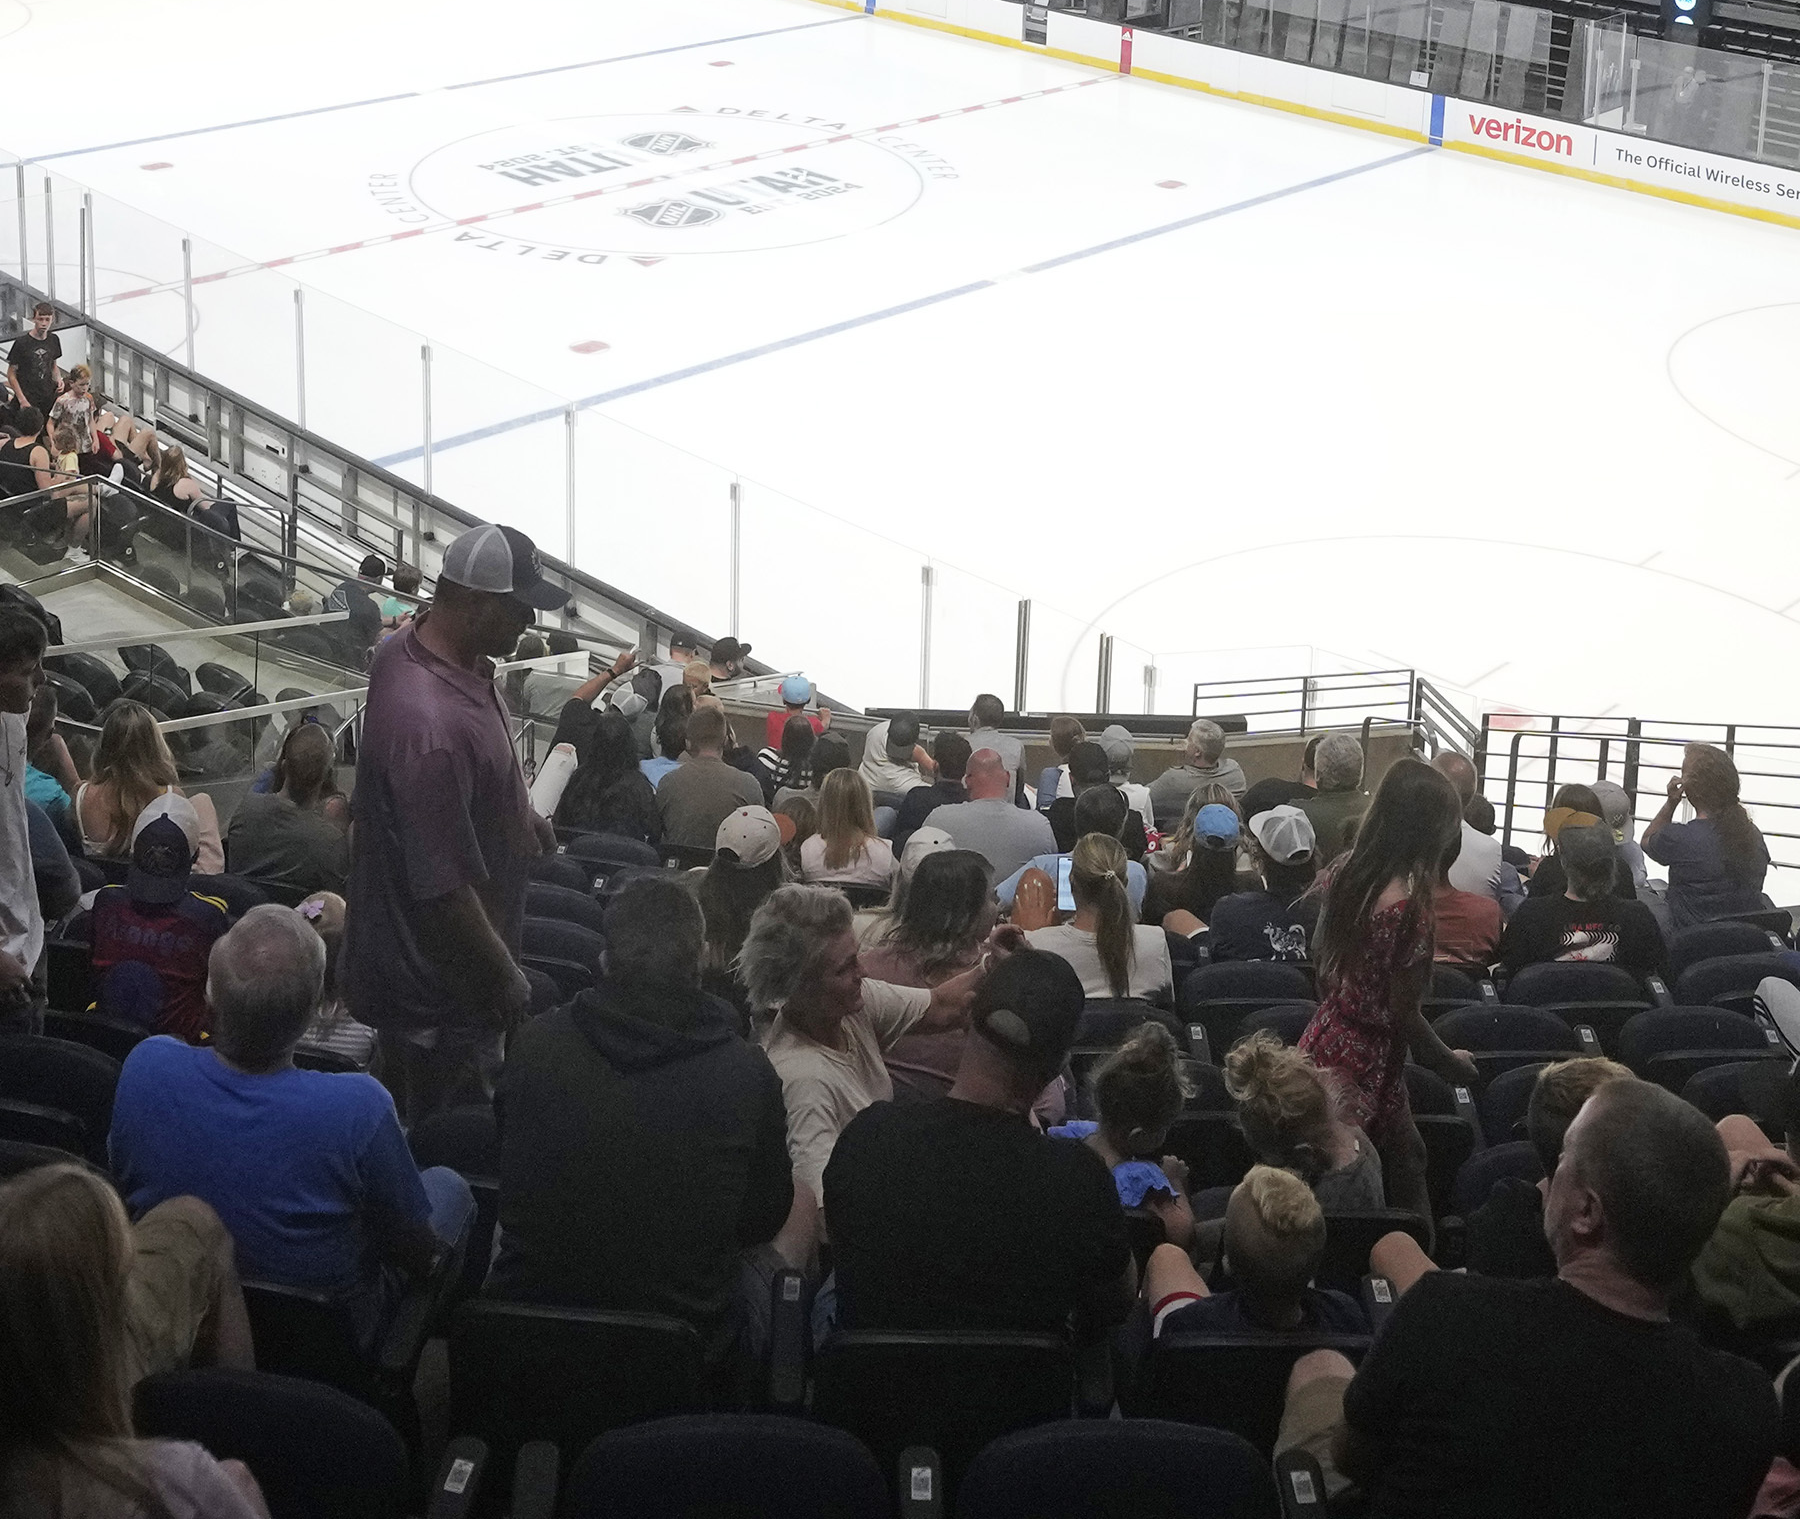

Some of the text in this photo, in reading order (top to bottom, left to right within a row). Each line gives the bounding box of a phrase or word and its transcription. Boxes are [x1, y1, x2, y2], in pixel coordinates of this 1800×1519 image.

[715, 107, 960, 181] DELTA CENTER
[1468, 112, 1573, 157] verizon
[1615, 147, 1643, 167] The
[1646, 154, 1701, 179] Official
[1705, 166, 1771, 194] Wireless
[453, 230, 608, 266] DELTA
